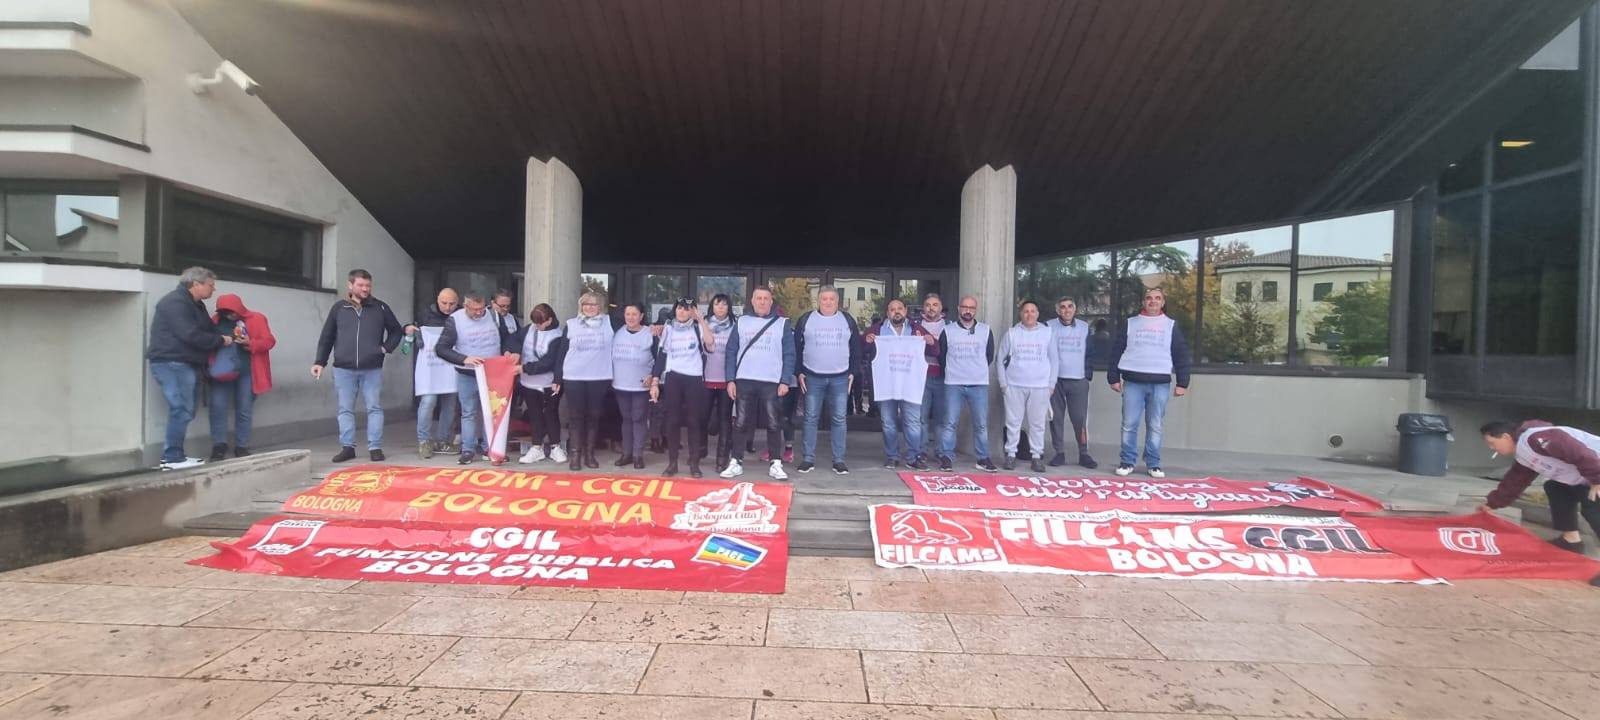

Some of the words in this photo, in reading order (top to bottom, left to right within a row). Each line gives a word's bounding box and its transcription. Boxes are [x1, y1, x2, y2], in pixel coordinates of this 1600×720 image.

[425, 469, 548, 491] FIOM
[582, 477, 682, 501] CGIL
[292, 495, 364, 513] BOLOGNA
[408, 491, 653, 523] BOLOGNA
[693, 512, 732, 521] Bologna
[469, 527, 562, 550] CGIL
[1000, 517, 1238, 551] FILCAMS
[1243, 526, 1392, 554] CGIL
[315, 547, 498, 563] FUNZIONE
[503, 553, 676, 569] PUBBLICA
[881, 544, 999, 564] FILCAMS
[1106, 548, 1318, 576] BOLOGNA
[360, 559, 589, 581] BOLOGNA
